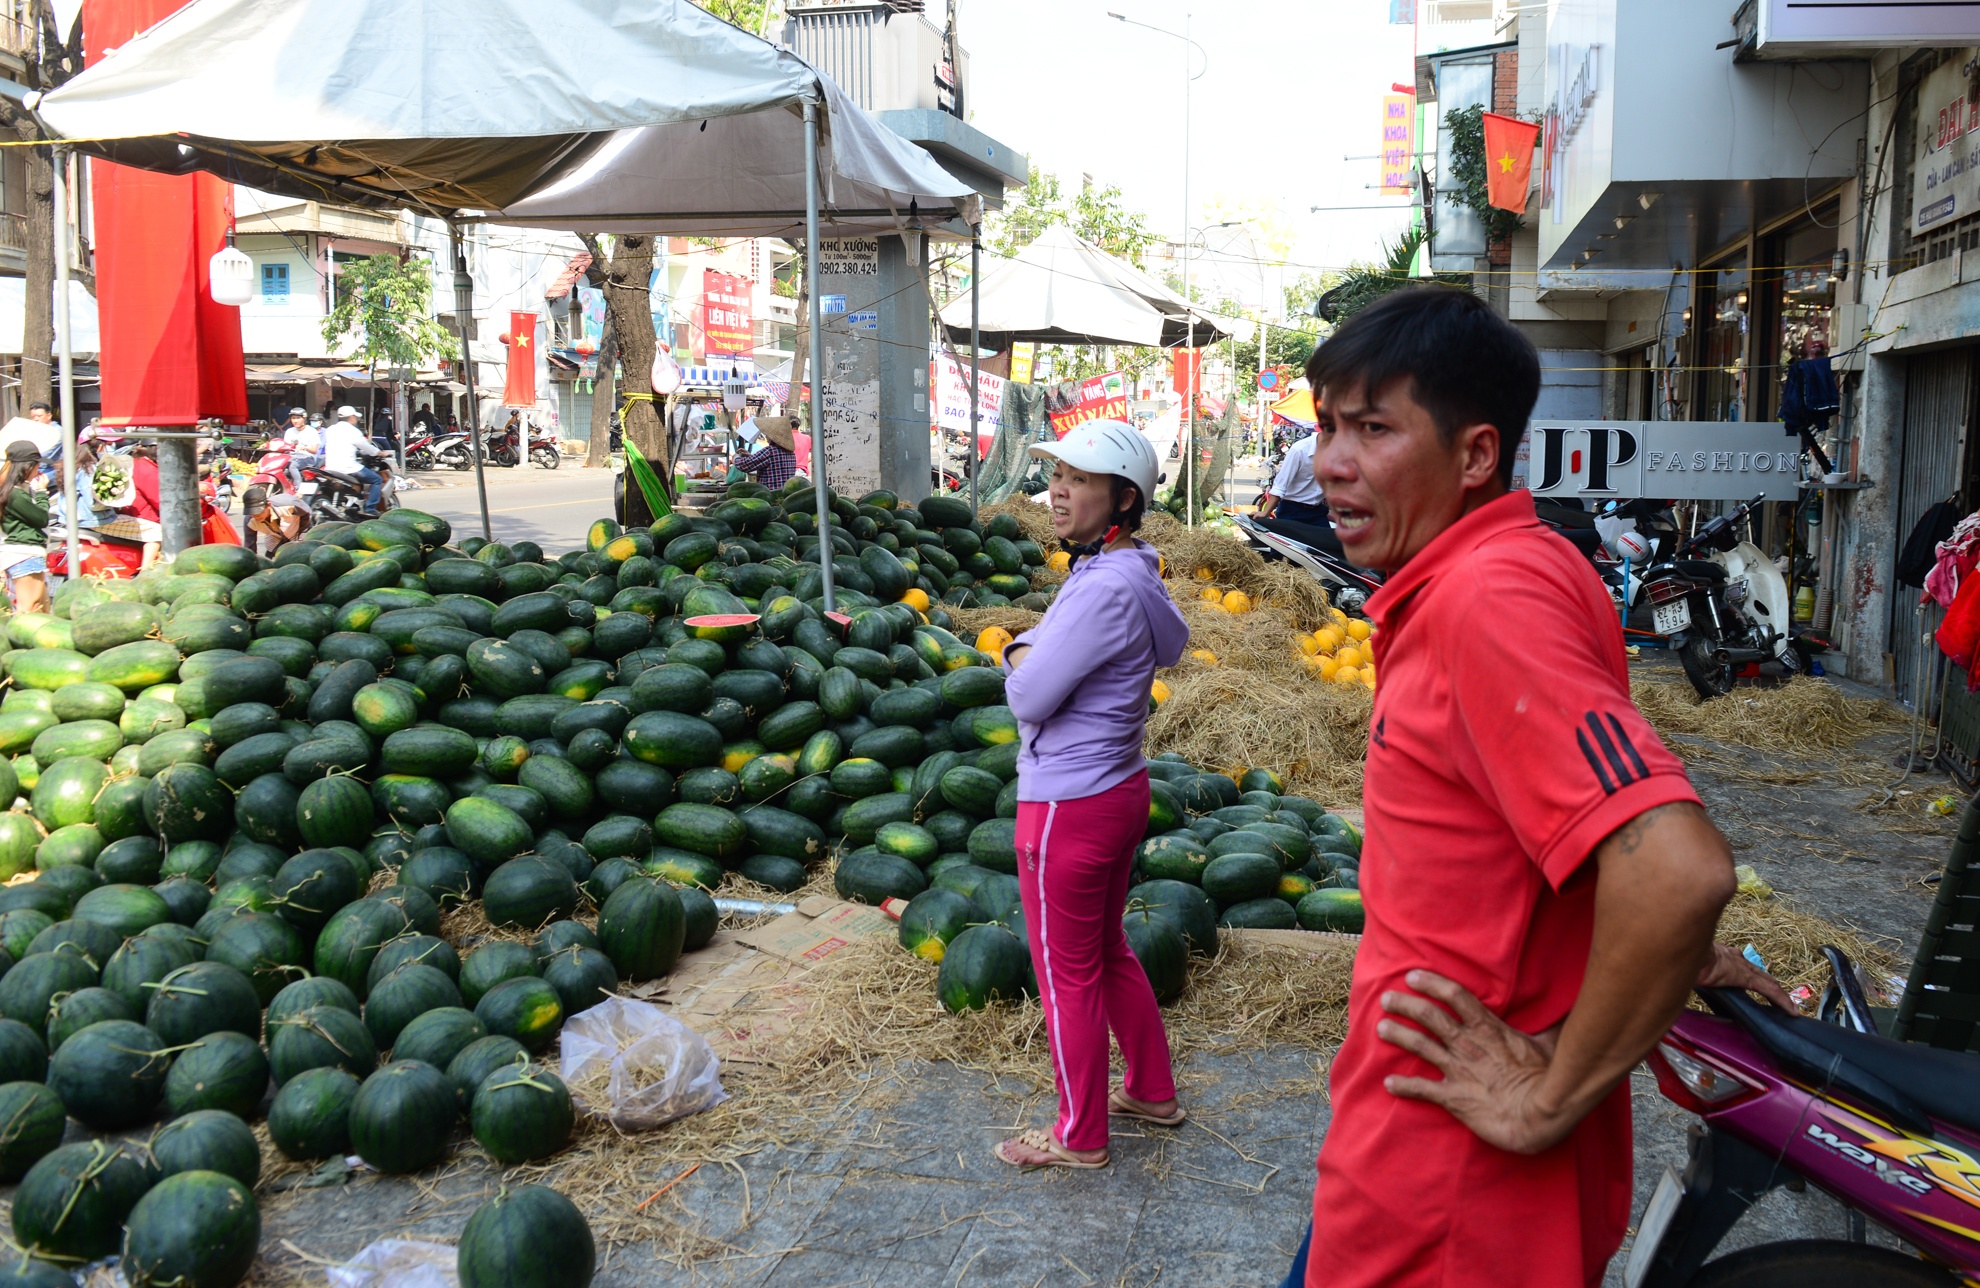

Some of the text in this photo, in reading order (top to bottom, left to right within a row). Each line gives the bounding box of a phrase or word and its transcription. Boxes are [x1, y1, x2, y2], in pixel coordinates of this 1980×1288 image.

[1388, 102, 1406, 118] NHA
[1384, 125, 1407, 141] KHOA
[1386, 146, 1405, 167] VIỆT
[843, 238, 877, 252] XƯỞNG
[819, 262, 877, 274] 0902.380.424
[1083, 383, 1105, 401] VÀNG
[1053, 400, 1126, 433] XUÂN LAN
[1646, 451, 1799, 473] FASHION
